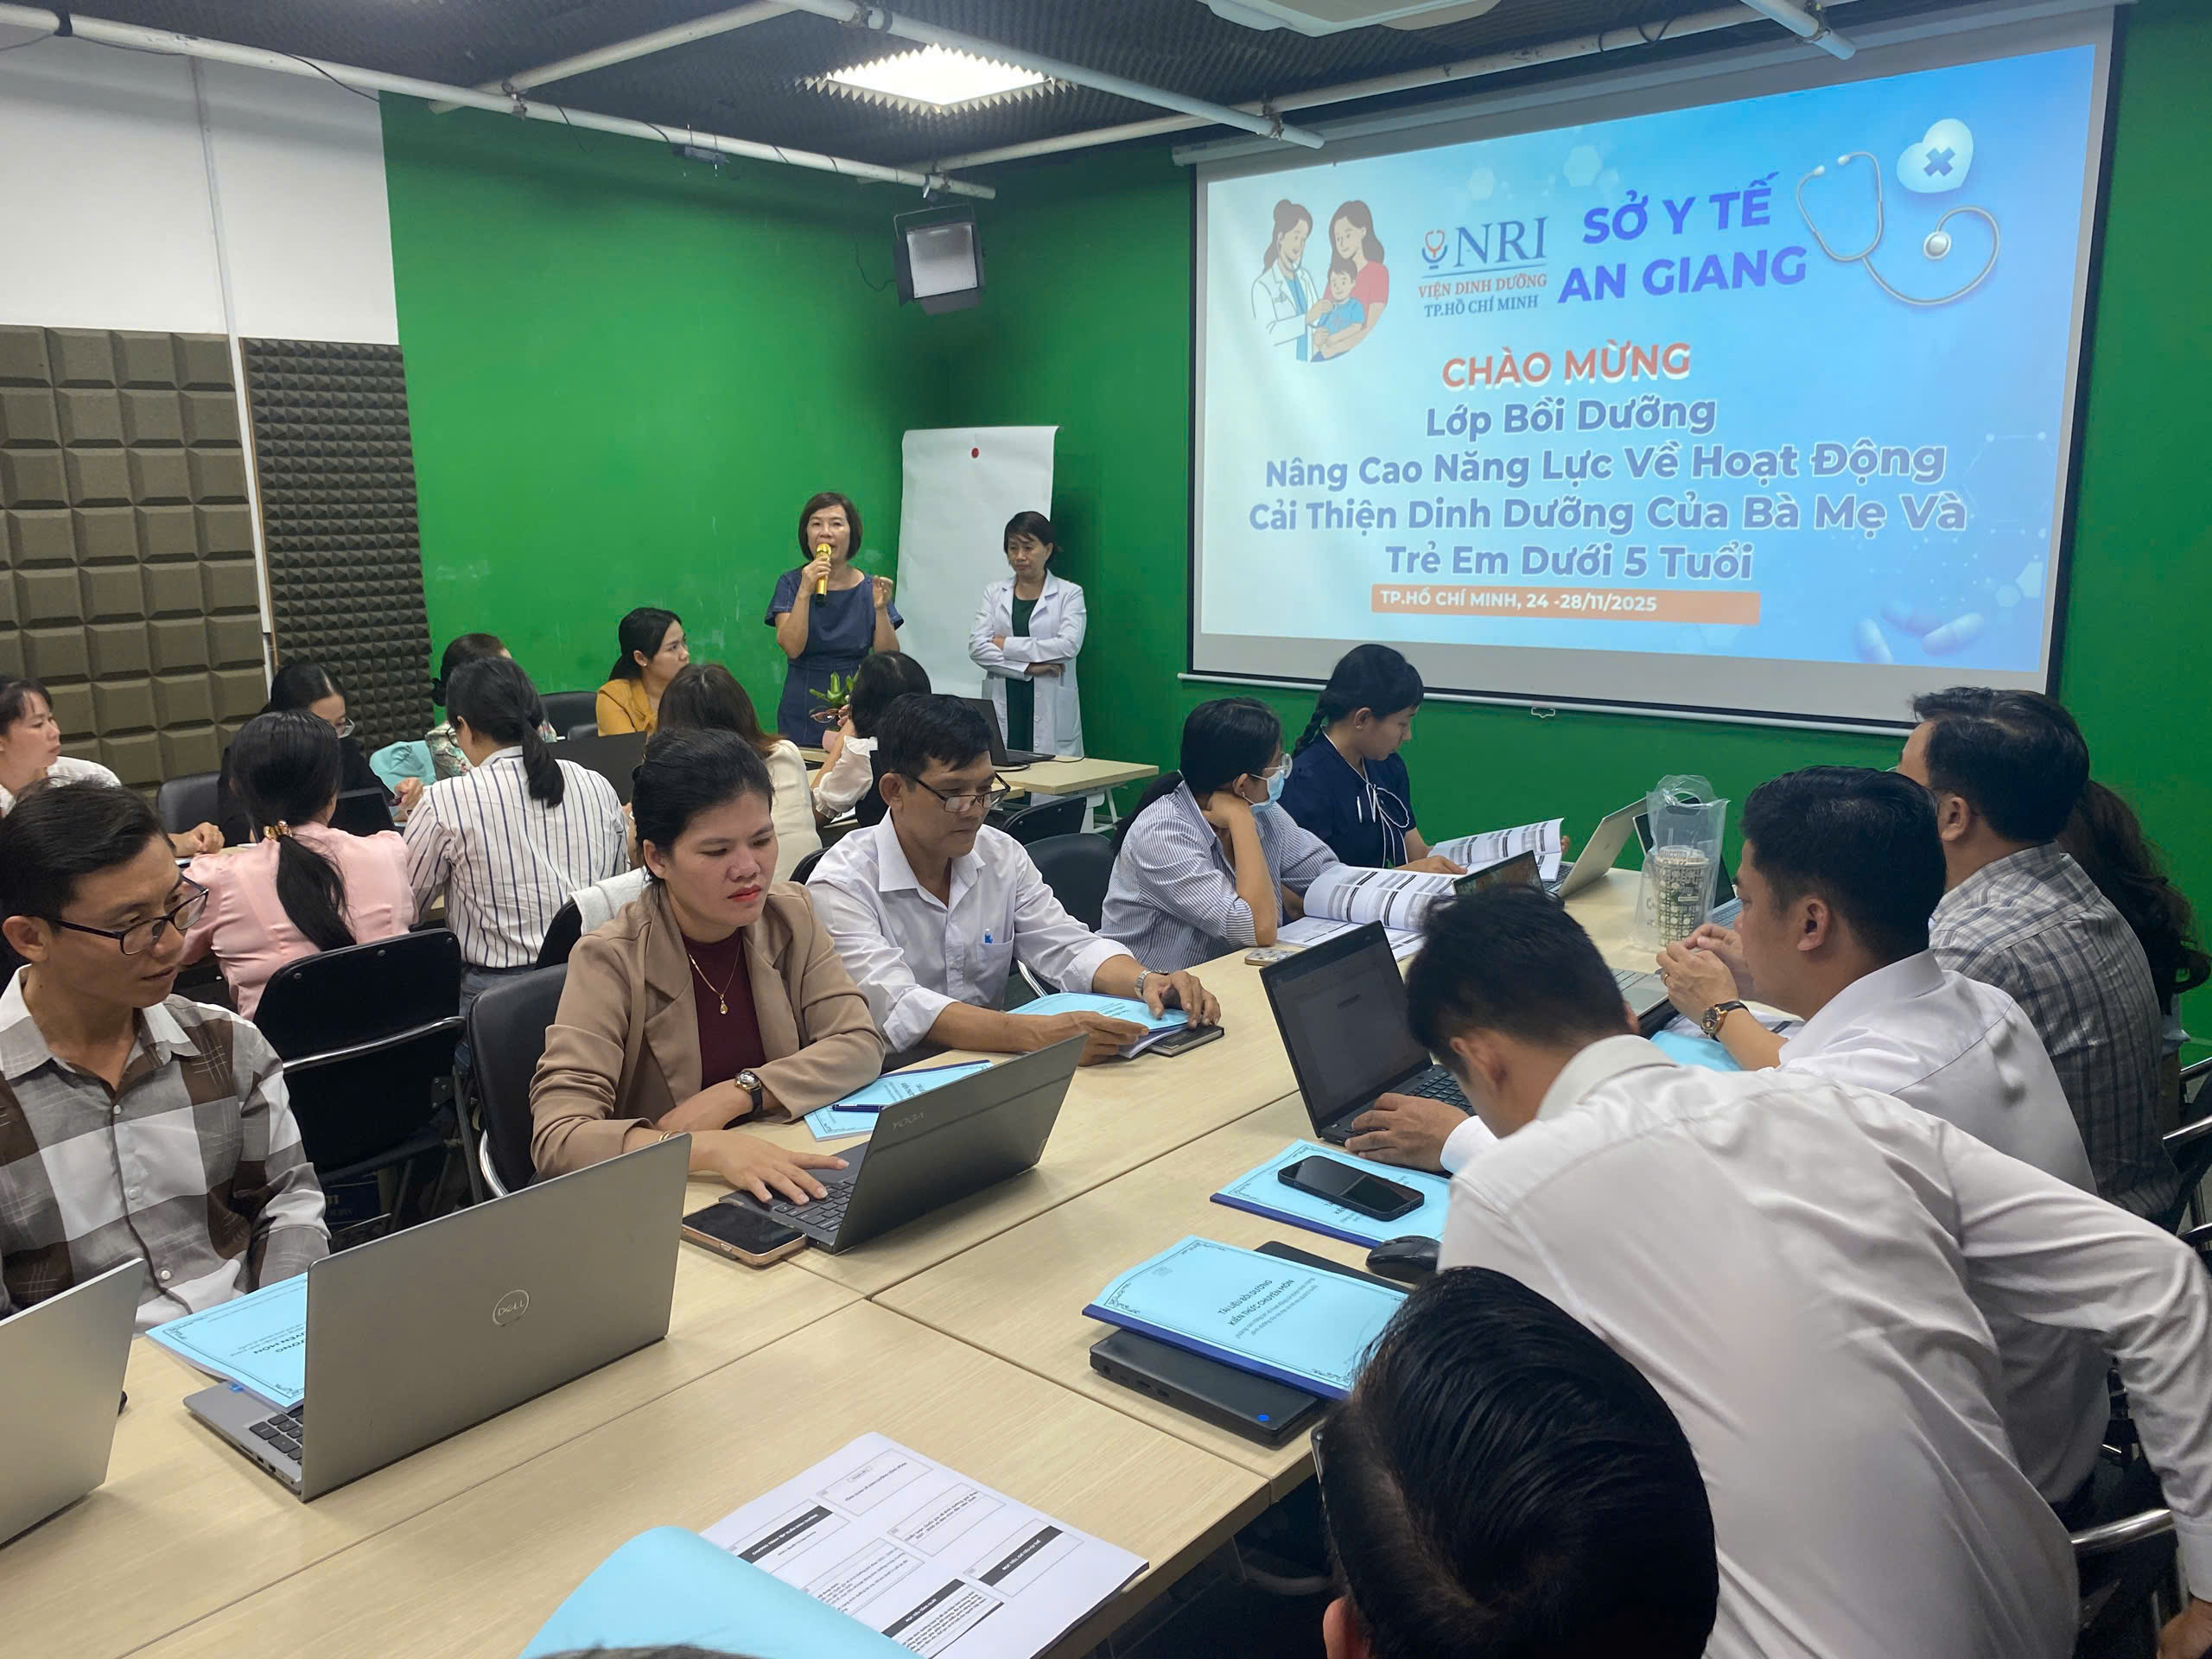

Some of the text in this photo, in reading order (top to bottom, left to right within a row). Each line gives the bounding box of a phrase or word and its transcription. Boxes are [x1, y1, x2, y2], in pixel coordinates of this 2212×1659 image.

[1583, 171, 1780, 245] SỞ Y TẾ
[1453, 216, 1549, 268] NRI
[1418, 272, 1548, 300] VIỆN DINH DƯỠNG
[1557, 245, 1807, 303] AN GIANG
[1424, 294, 1539, 317] TP.HỒ CHÍ MINH
[1441, 339, 1691, 391] CHÀO MỪNG
[1426, 394, 1717, 443] Lớp Bồi Dưỡng
[1266, 437, 1947, 493] Nâng Cao Năng Lực Về Hoạt Động
[1249, 490, 1967, 537] Cải Thiện Dinh Dưỡng Của Bà Mẹ Và
[1385, 540, 1753, 581] Trẻ Em Dưới 5 Tuổi
[1435, 589, 1466, 607] CHÍ
[1470, 593, 1522, 610] MINH,
[1526, 594, 1549, 608] 24
[1553, 593, 1658, 613] -28/11/2025
